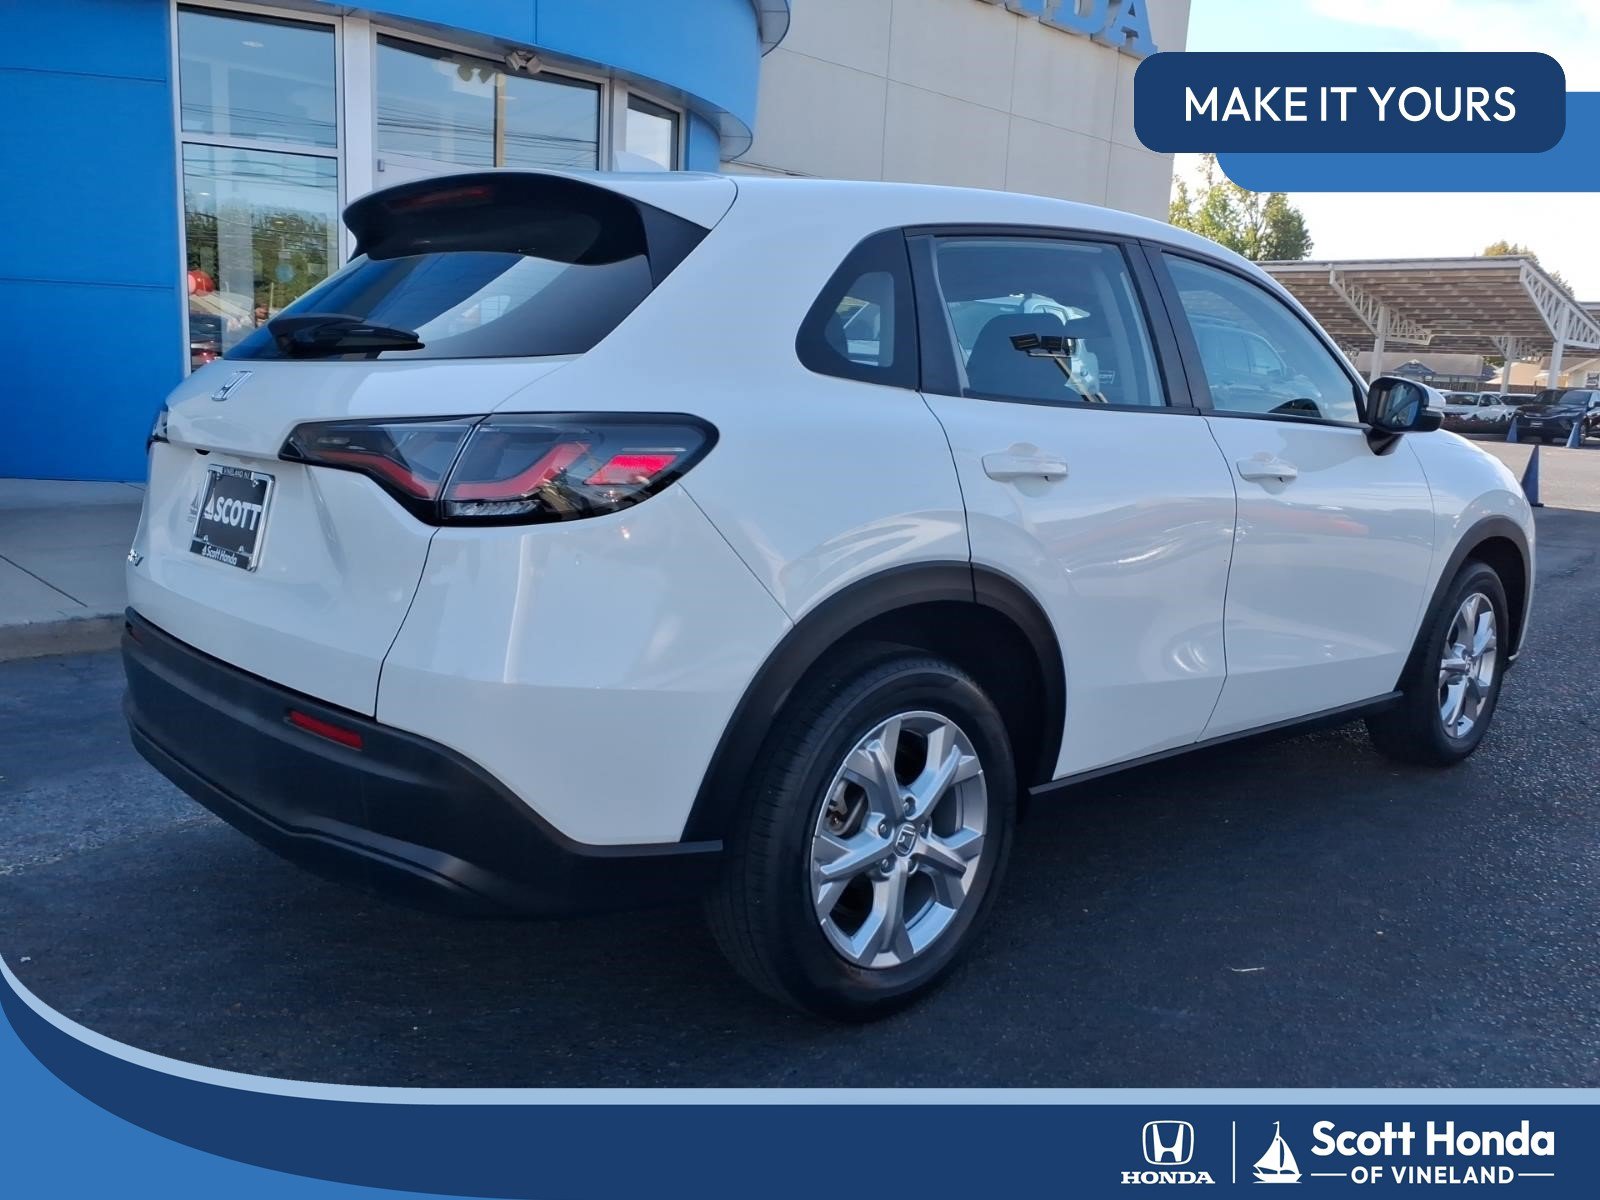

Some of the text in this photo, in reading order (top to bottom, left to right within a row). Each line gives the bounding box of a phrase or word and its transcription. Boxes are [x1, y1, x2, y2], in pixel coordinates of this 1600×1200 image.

[213, 496, 262, 531] SCOTT
[206, 545, 238, 566] Scott Honda
